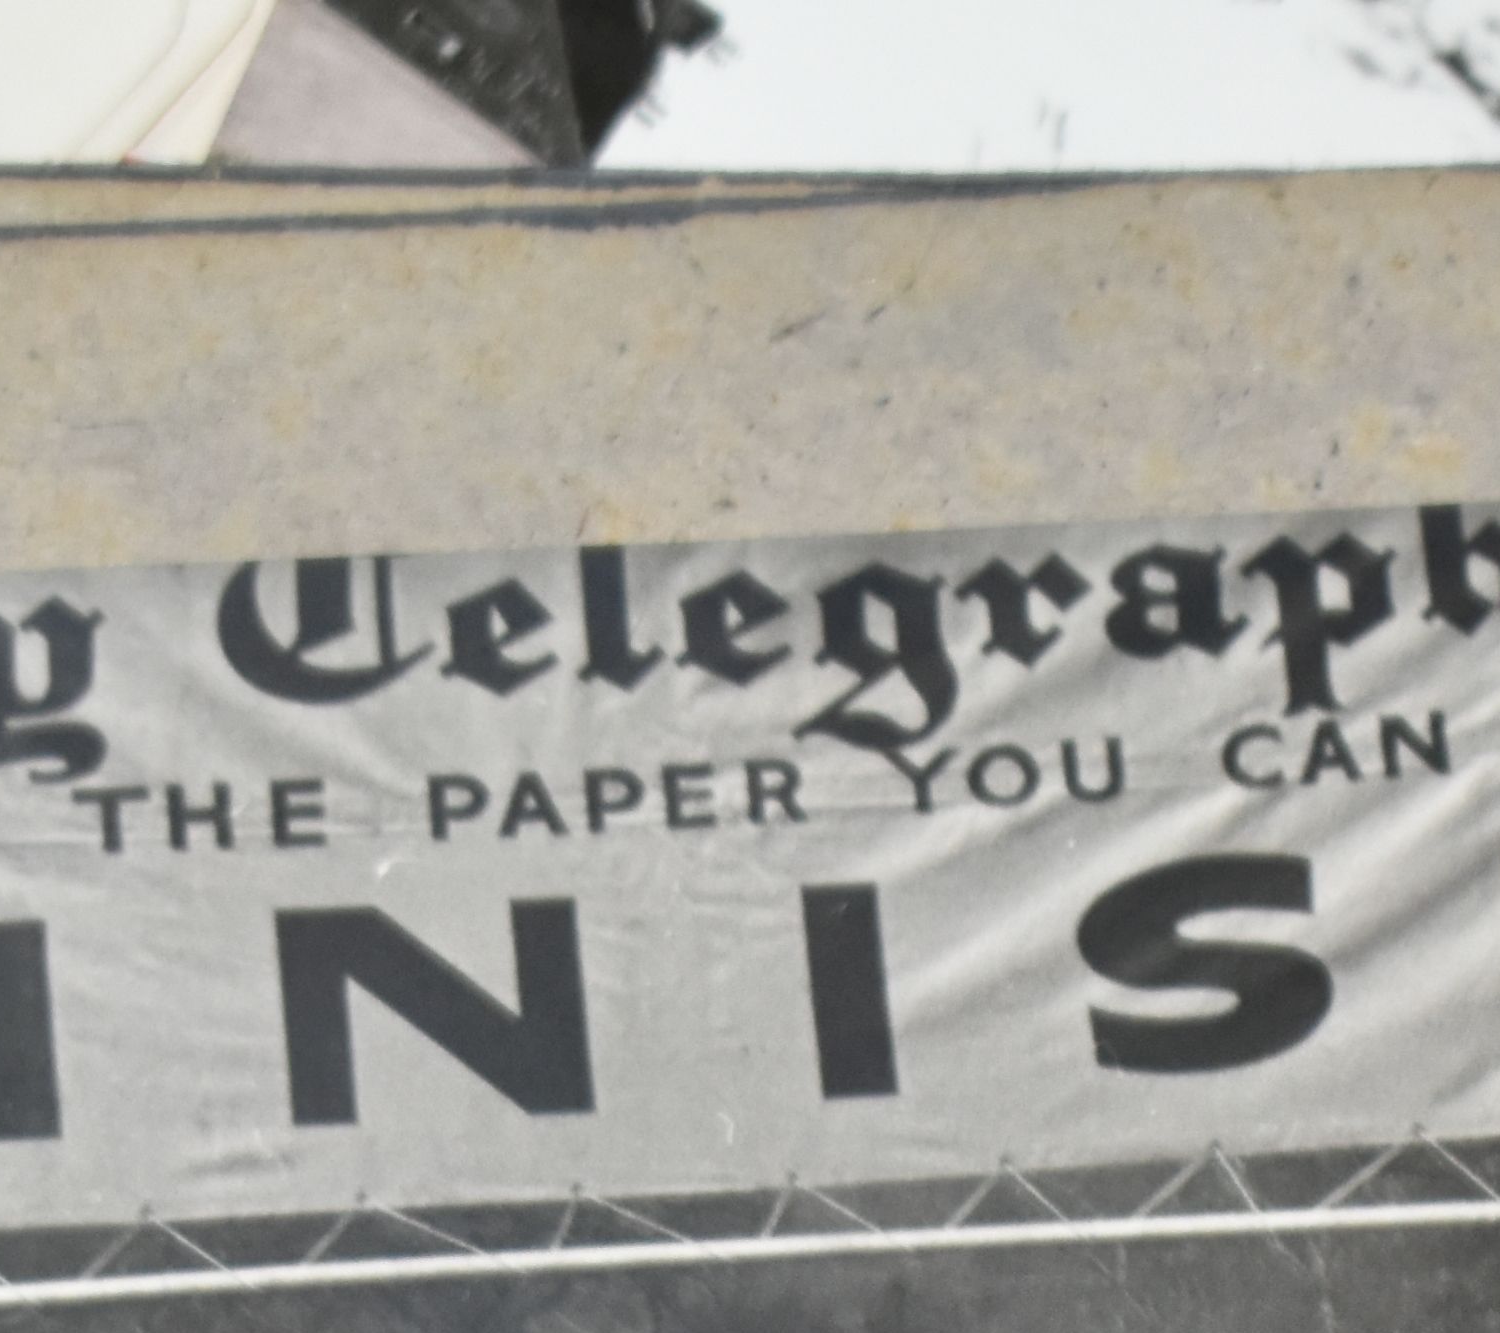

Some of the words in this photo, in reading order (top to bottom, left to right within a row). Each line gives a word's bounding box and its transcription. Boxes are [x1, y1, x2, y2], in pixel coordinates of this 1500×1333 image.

[72, 776, 328, 854] THE
[426, 757, 808, 841] PAPER
[882, 735, 1126, 813] YOU
[1220, 709, 1453, 792] CAN
